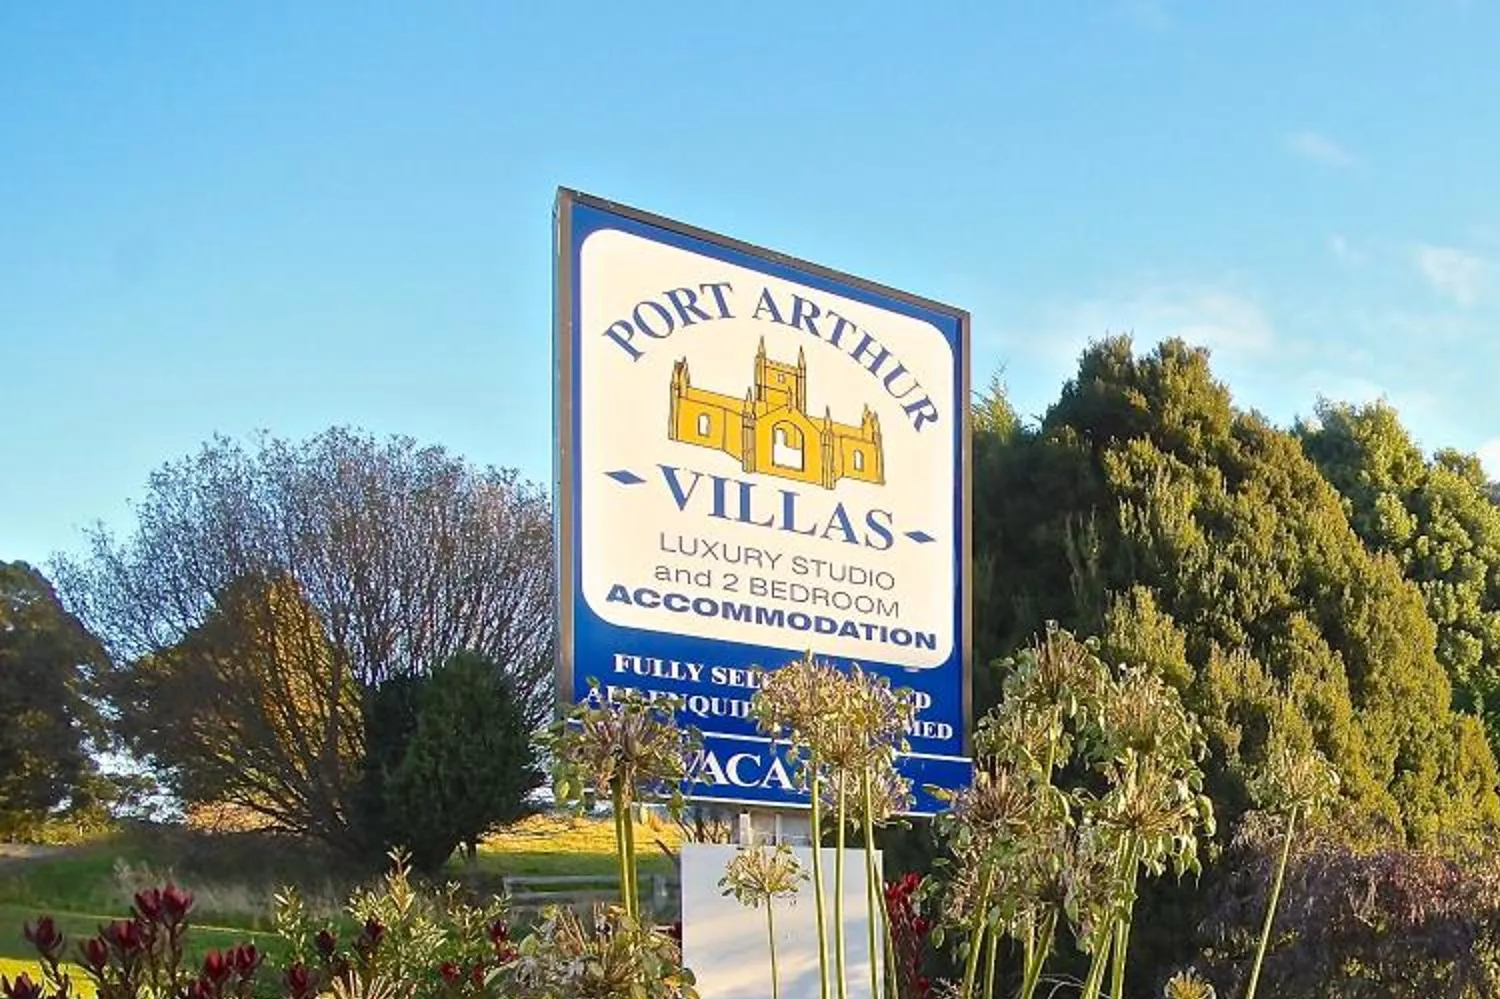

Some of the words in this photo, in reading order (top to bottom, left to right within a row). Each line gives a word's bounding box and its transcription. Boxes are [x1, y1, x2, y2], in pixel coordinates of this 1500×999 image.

[602, 281, 737, 362] PORT
[752, 287, 939, 432] ARTHUR
[656, 463, 894, 551] VILLAS
[655, 565, 712, 588] and
[722, 573, 739, 592] 2
[750, 577, 900, 619] BEDROOM
[660, 532, 783, 570] LUXURY
[791, 555, 896, 591] STUDIO
[605, 583, 937, 651] ACCOMMODATION
[613, 653, 704, 683] FULLY
